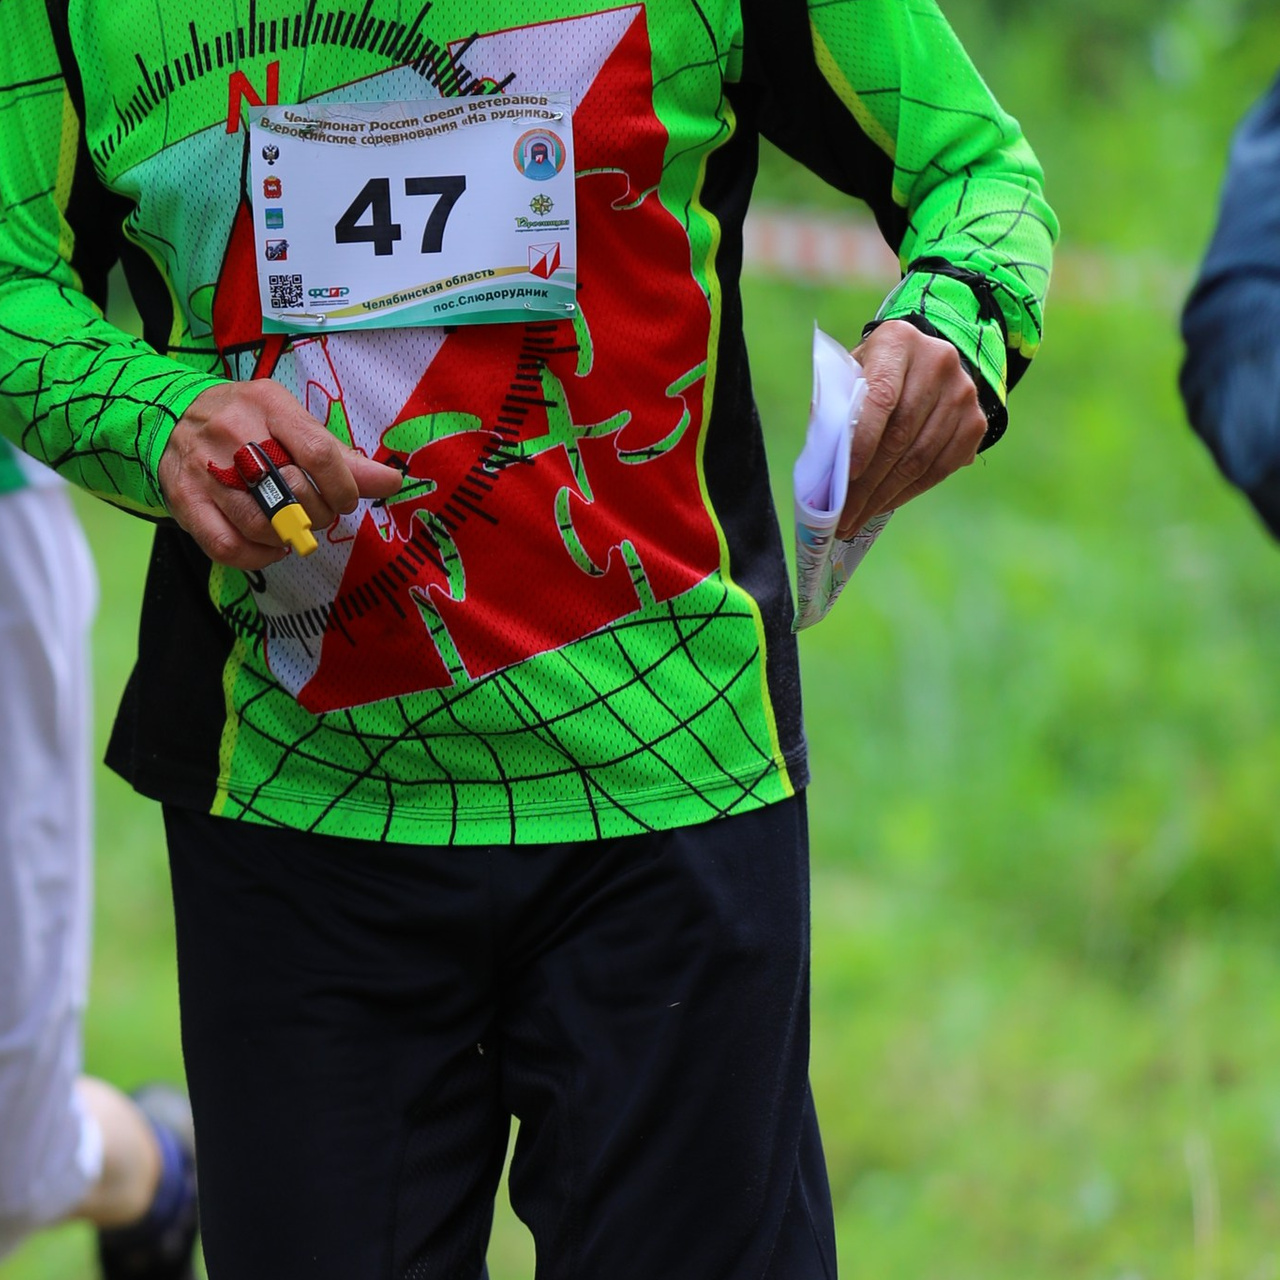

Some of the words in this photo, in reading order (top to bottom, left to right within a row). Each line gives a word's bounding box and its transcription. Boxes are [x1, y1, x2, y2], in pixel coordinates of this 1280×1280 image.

[361, 120, 458, 146] соревнования
[461, 112, 487, 126] «На
[369, 117, 419, 132] России
[423, 105, 465, 124] среди
[468, 95, 548, 112] ветеранов
[335, 175, 466, 256] 47
[362, 282, 443, 311] Челябинская
[445, 268, 495, 289] область
[433, 287, 549, 313] пос.Слюдорудник
